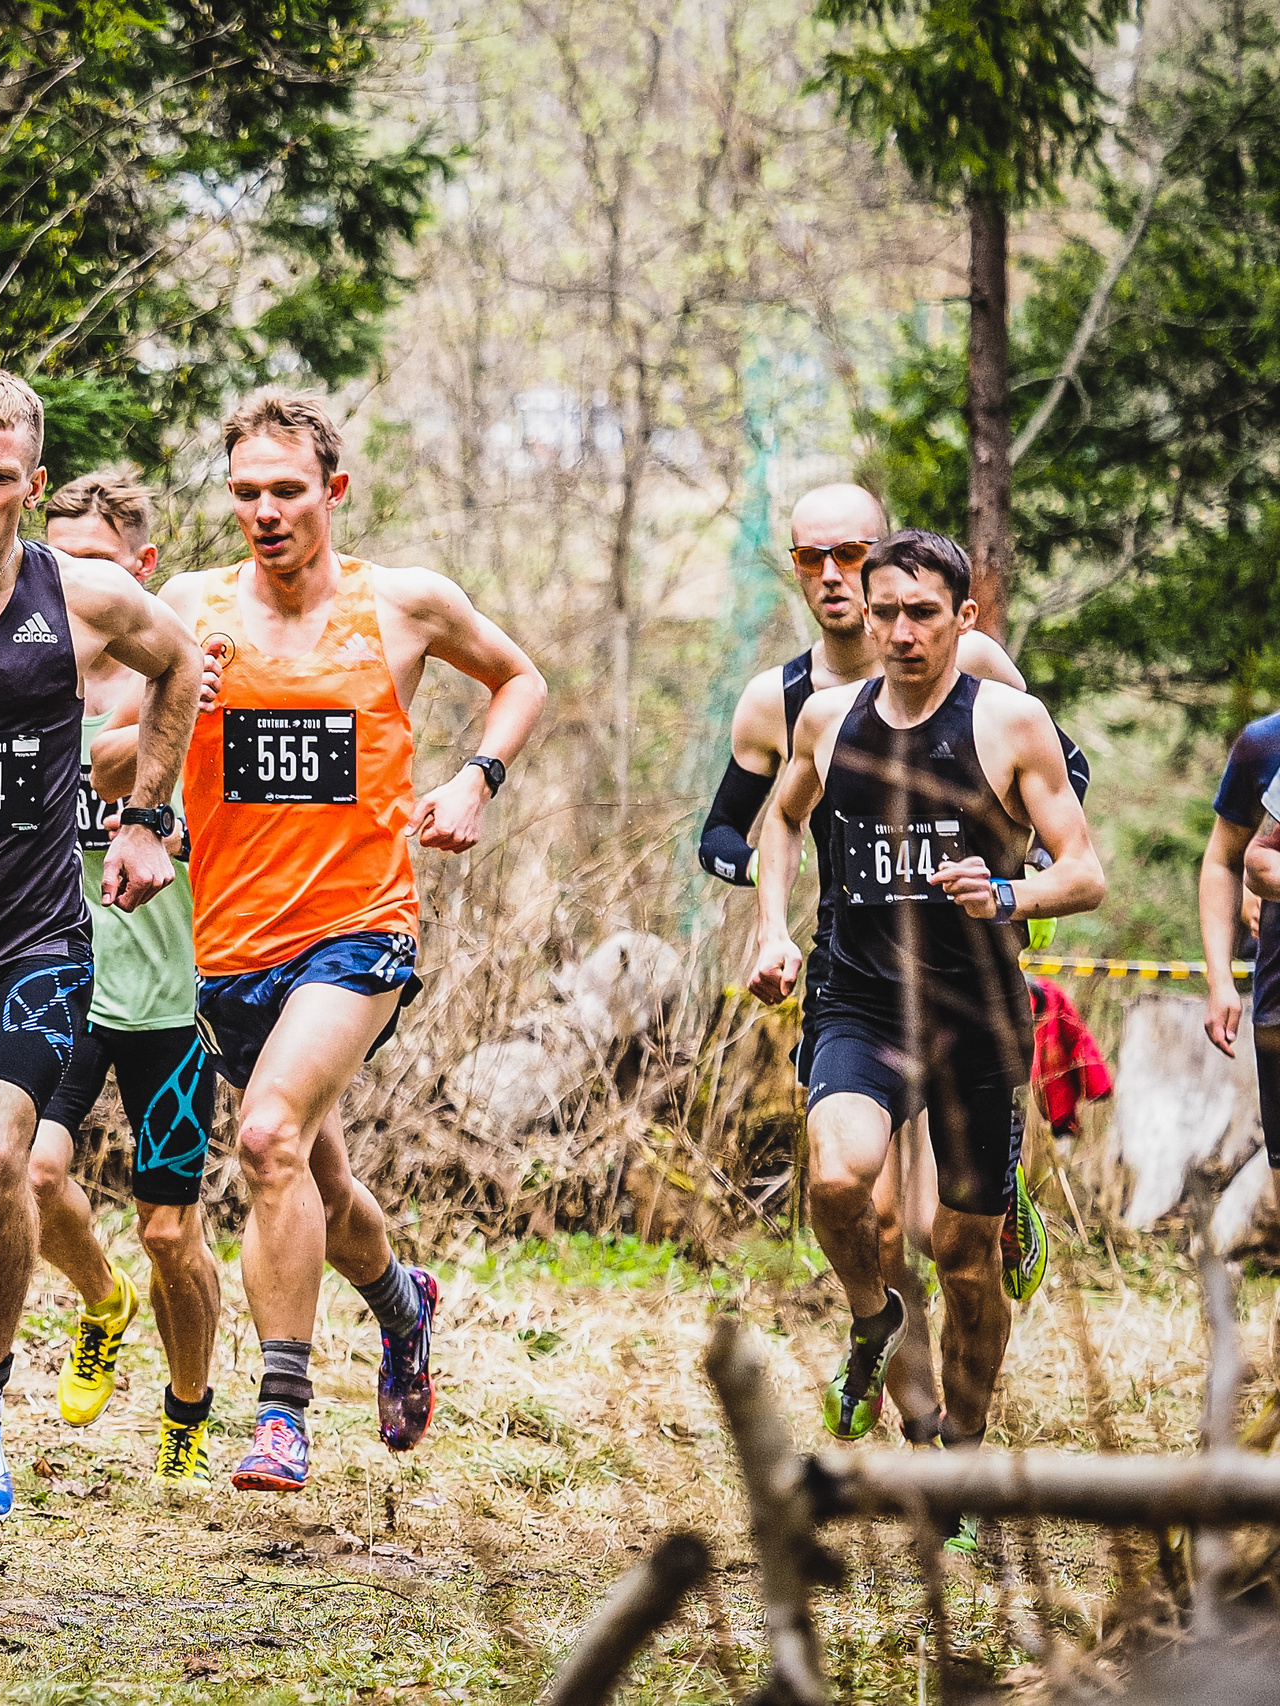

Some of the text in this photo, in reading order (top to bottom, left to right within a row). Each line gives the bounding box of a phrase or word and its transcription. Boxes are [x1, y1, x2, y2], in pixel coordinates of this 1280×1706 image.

[13, 631, 59, 643] adidas
[257, 735, 319, 782] 555
[874, 838, 936, 884] 644
